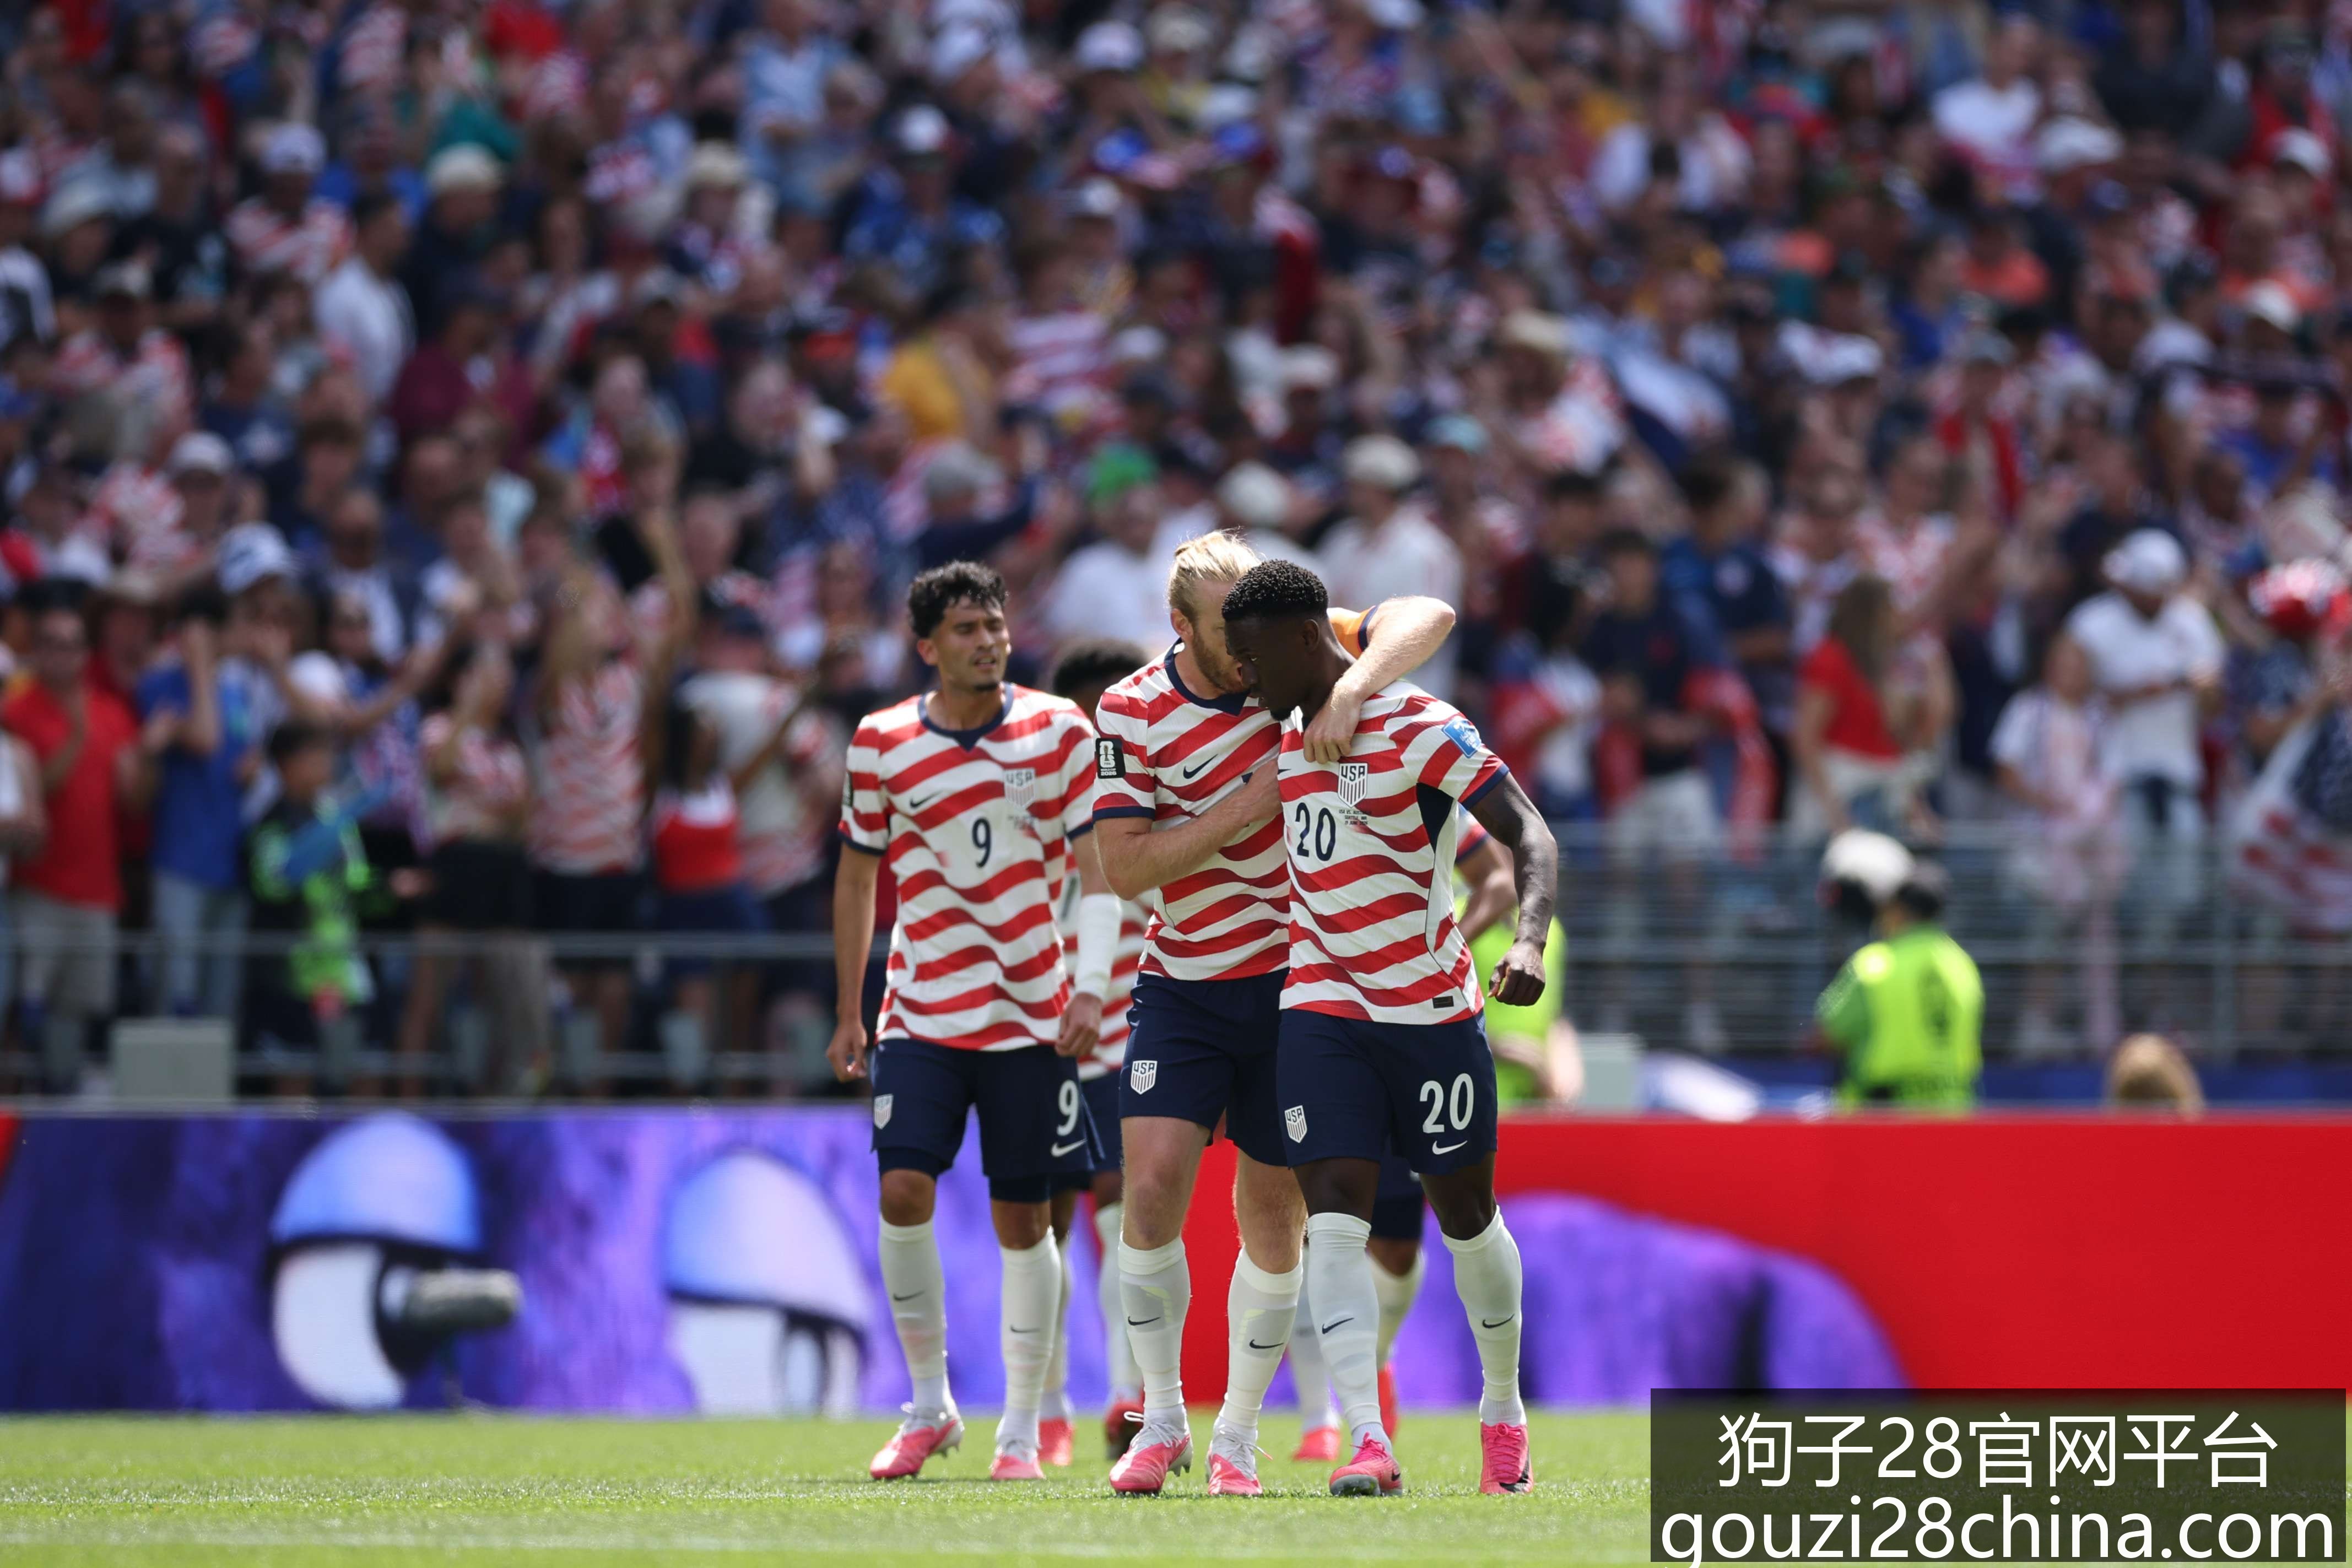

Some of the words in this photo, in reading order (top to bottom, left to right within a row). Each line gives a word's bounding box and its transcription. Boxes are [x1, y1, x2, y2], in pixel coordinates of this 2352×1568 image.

[1006, 771, 1032, 787] USA
[1341, 766, 1365, 781] USA
[972, 818, 991, 868] 9
[1295, 802, 1336, 862] 20
[1134, 1062, 1155, 1074] USA
[1057, 1080, 1079, 1136] 9
[1286, 1108, 1302, 1123] USA
[1420, 1073, 1474, 1134] 20
